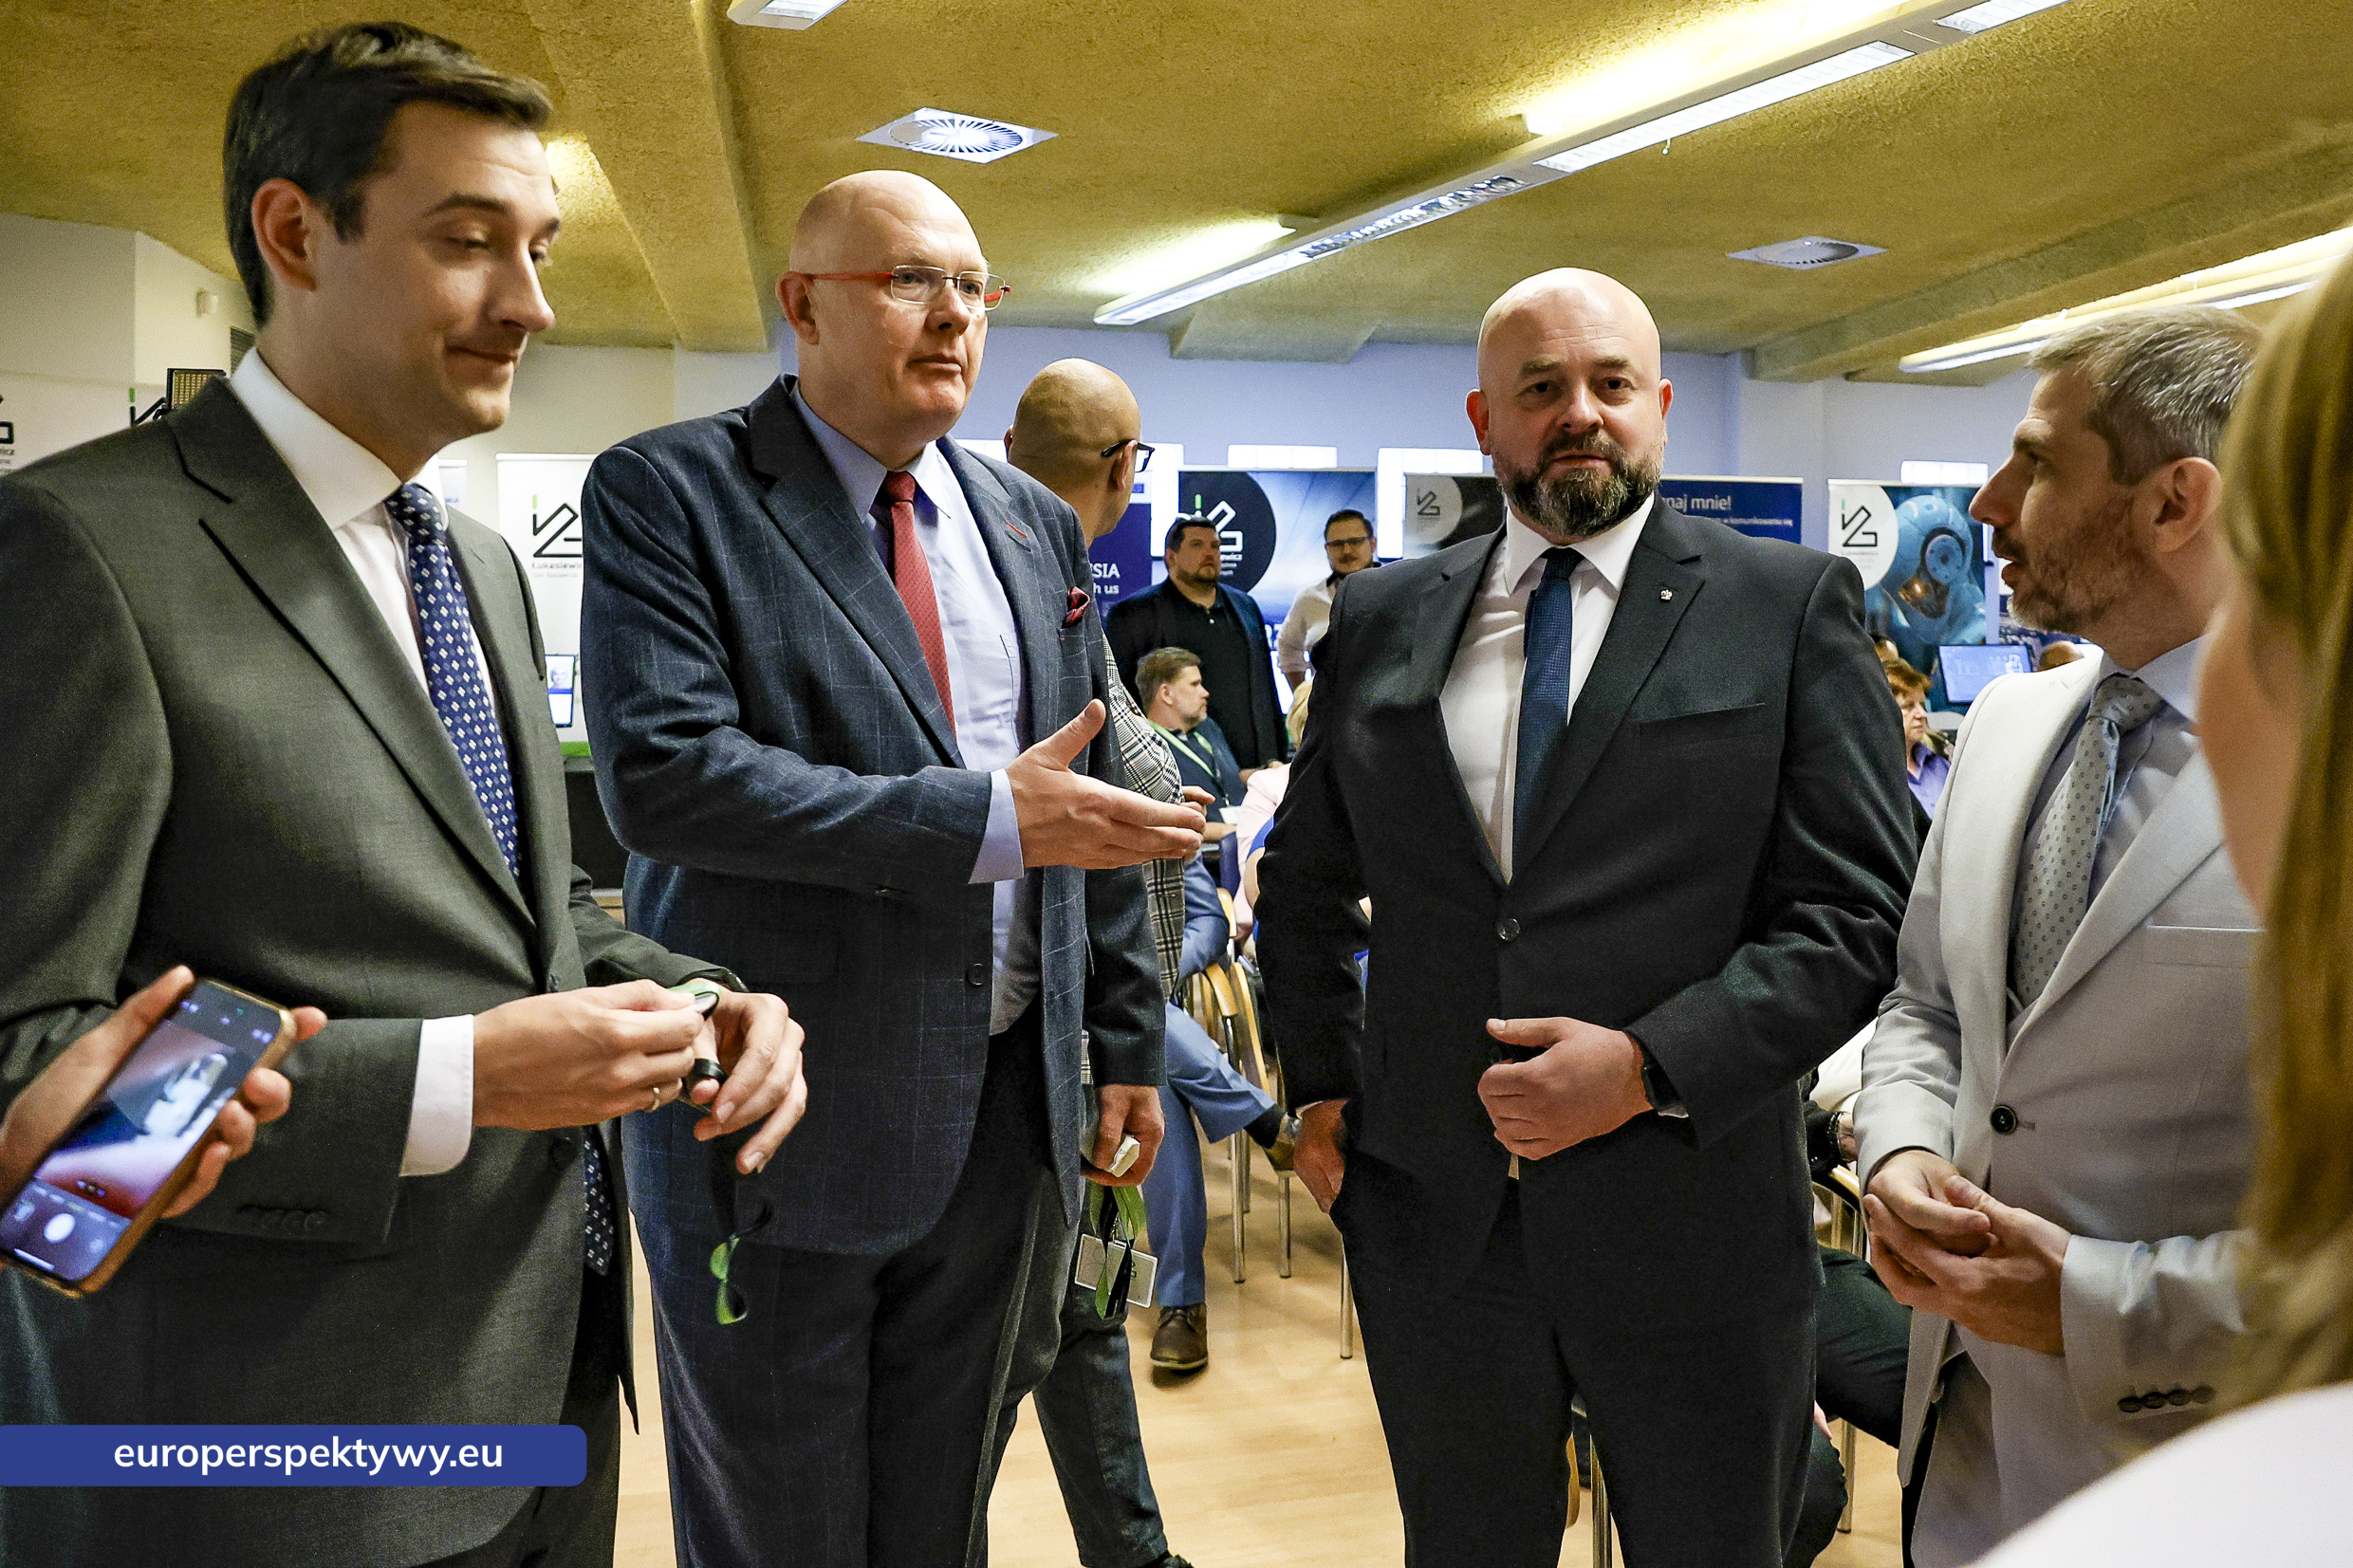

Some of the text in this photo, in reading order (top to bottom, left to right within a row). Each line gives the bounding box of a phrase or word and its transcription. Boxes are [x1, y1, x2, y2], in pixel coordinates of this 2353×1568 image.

[1691, 495, 1732, 510] mnie!
[1090, 563, 1121, 579] SIA
[1104, 584, 1120, 595] us
